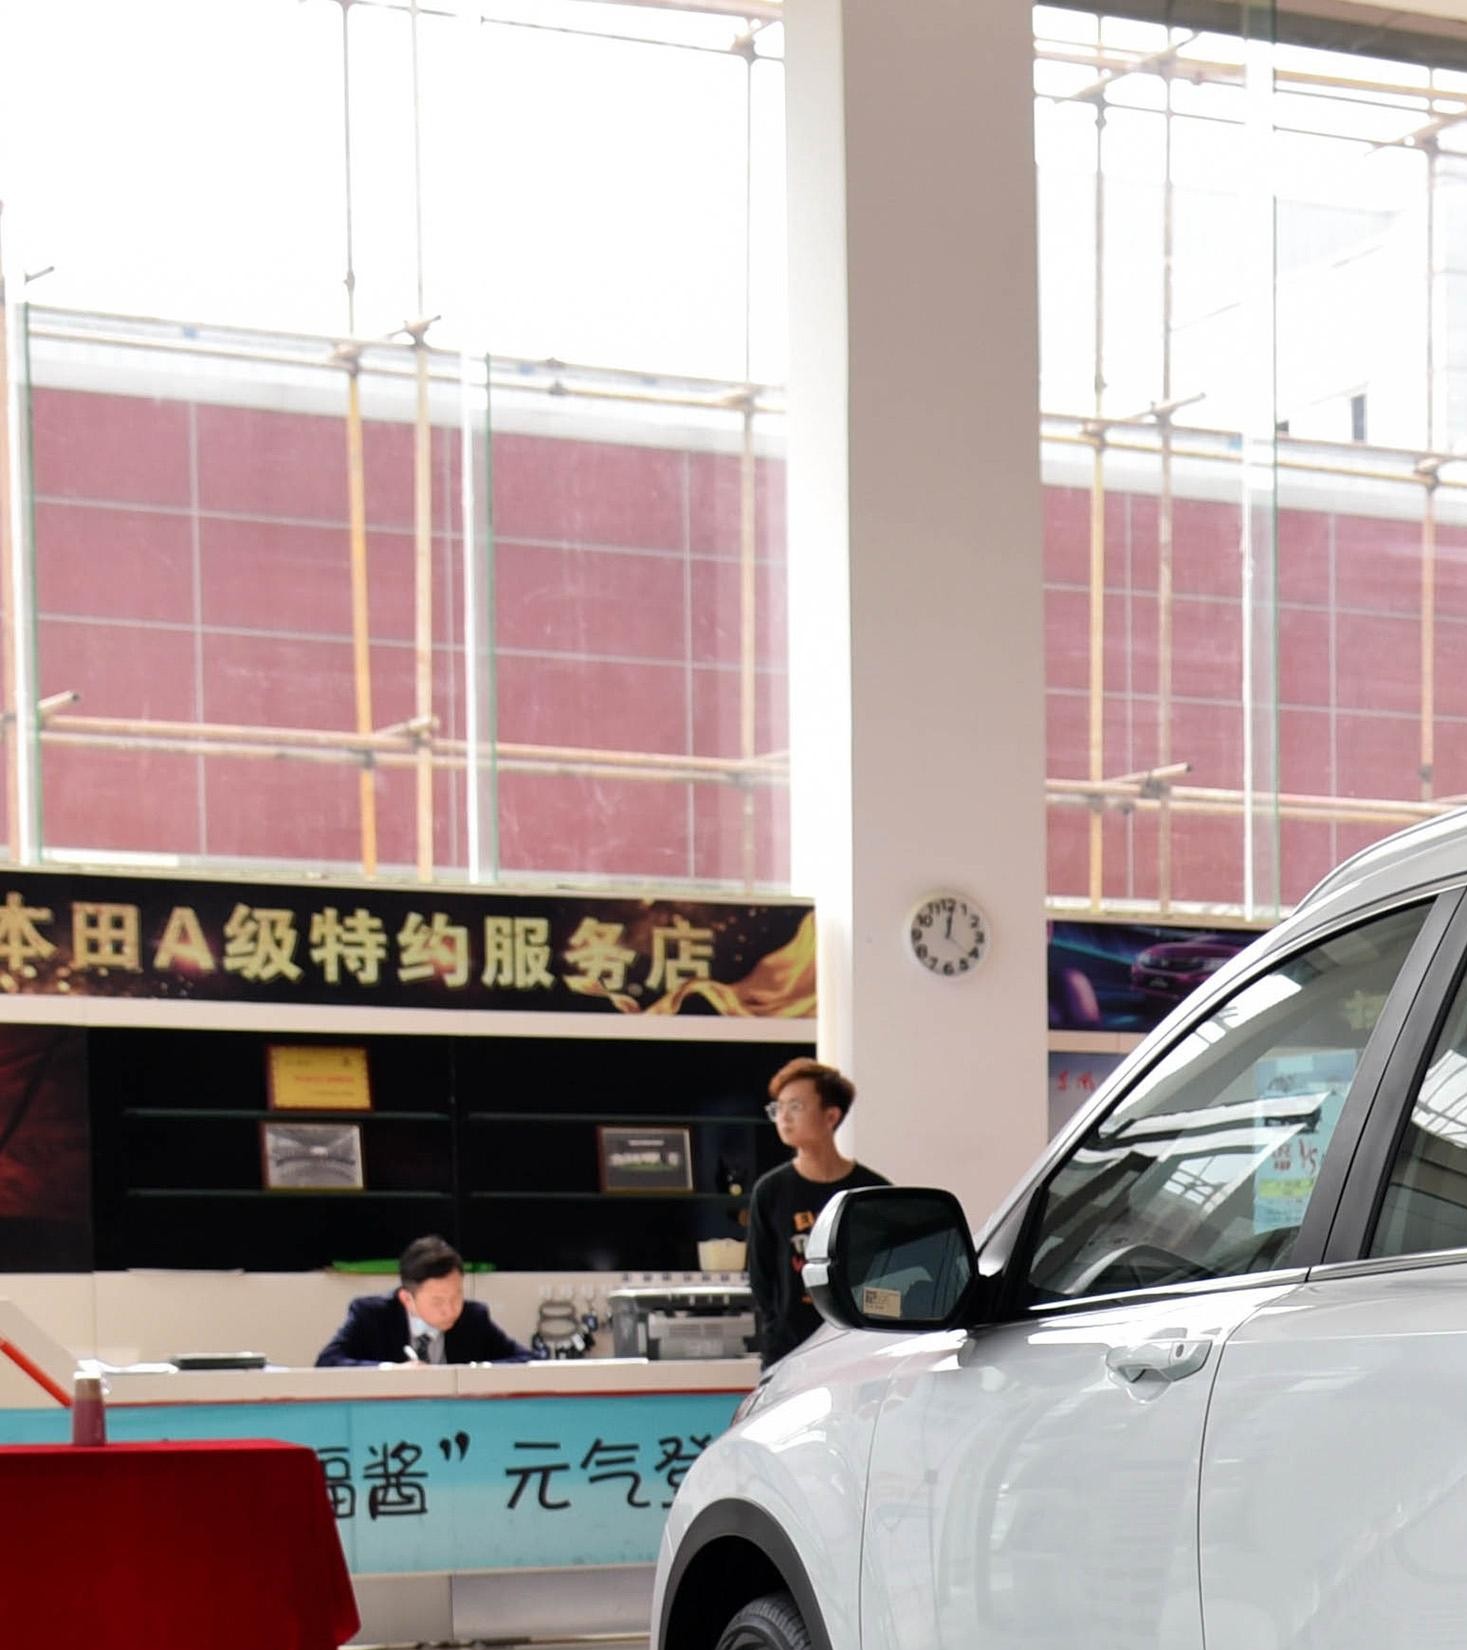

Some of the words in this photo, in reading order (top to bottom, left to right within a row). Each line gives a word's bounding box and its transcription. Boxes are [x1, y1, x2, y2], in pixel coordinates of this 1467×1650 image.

[0, 890, 717, 994] 本田A级特约服务店
